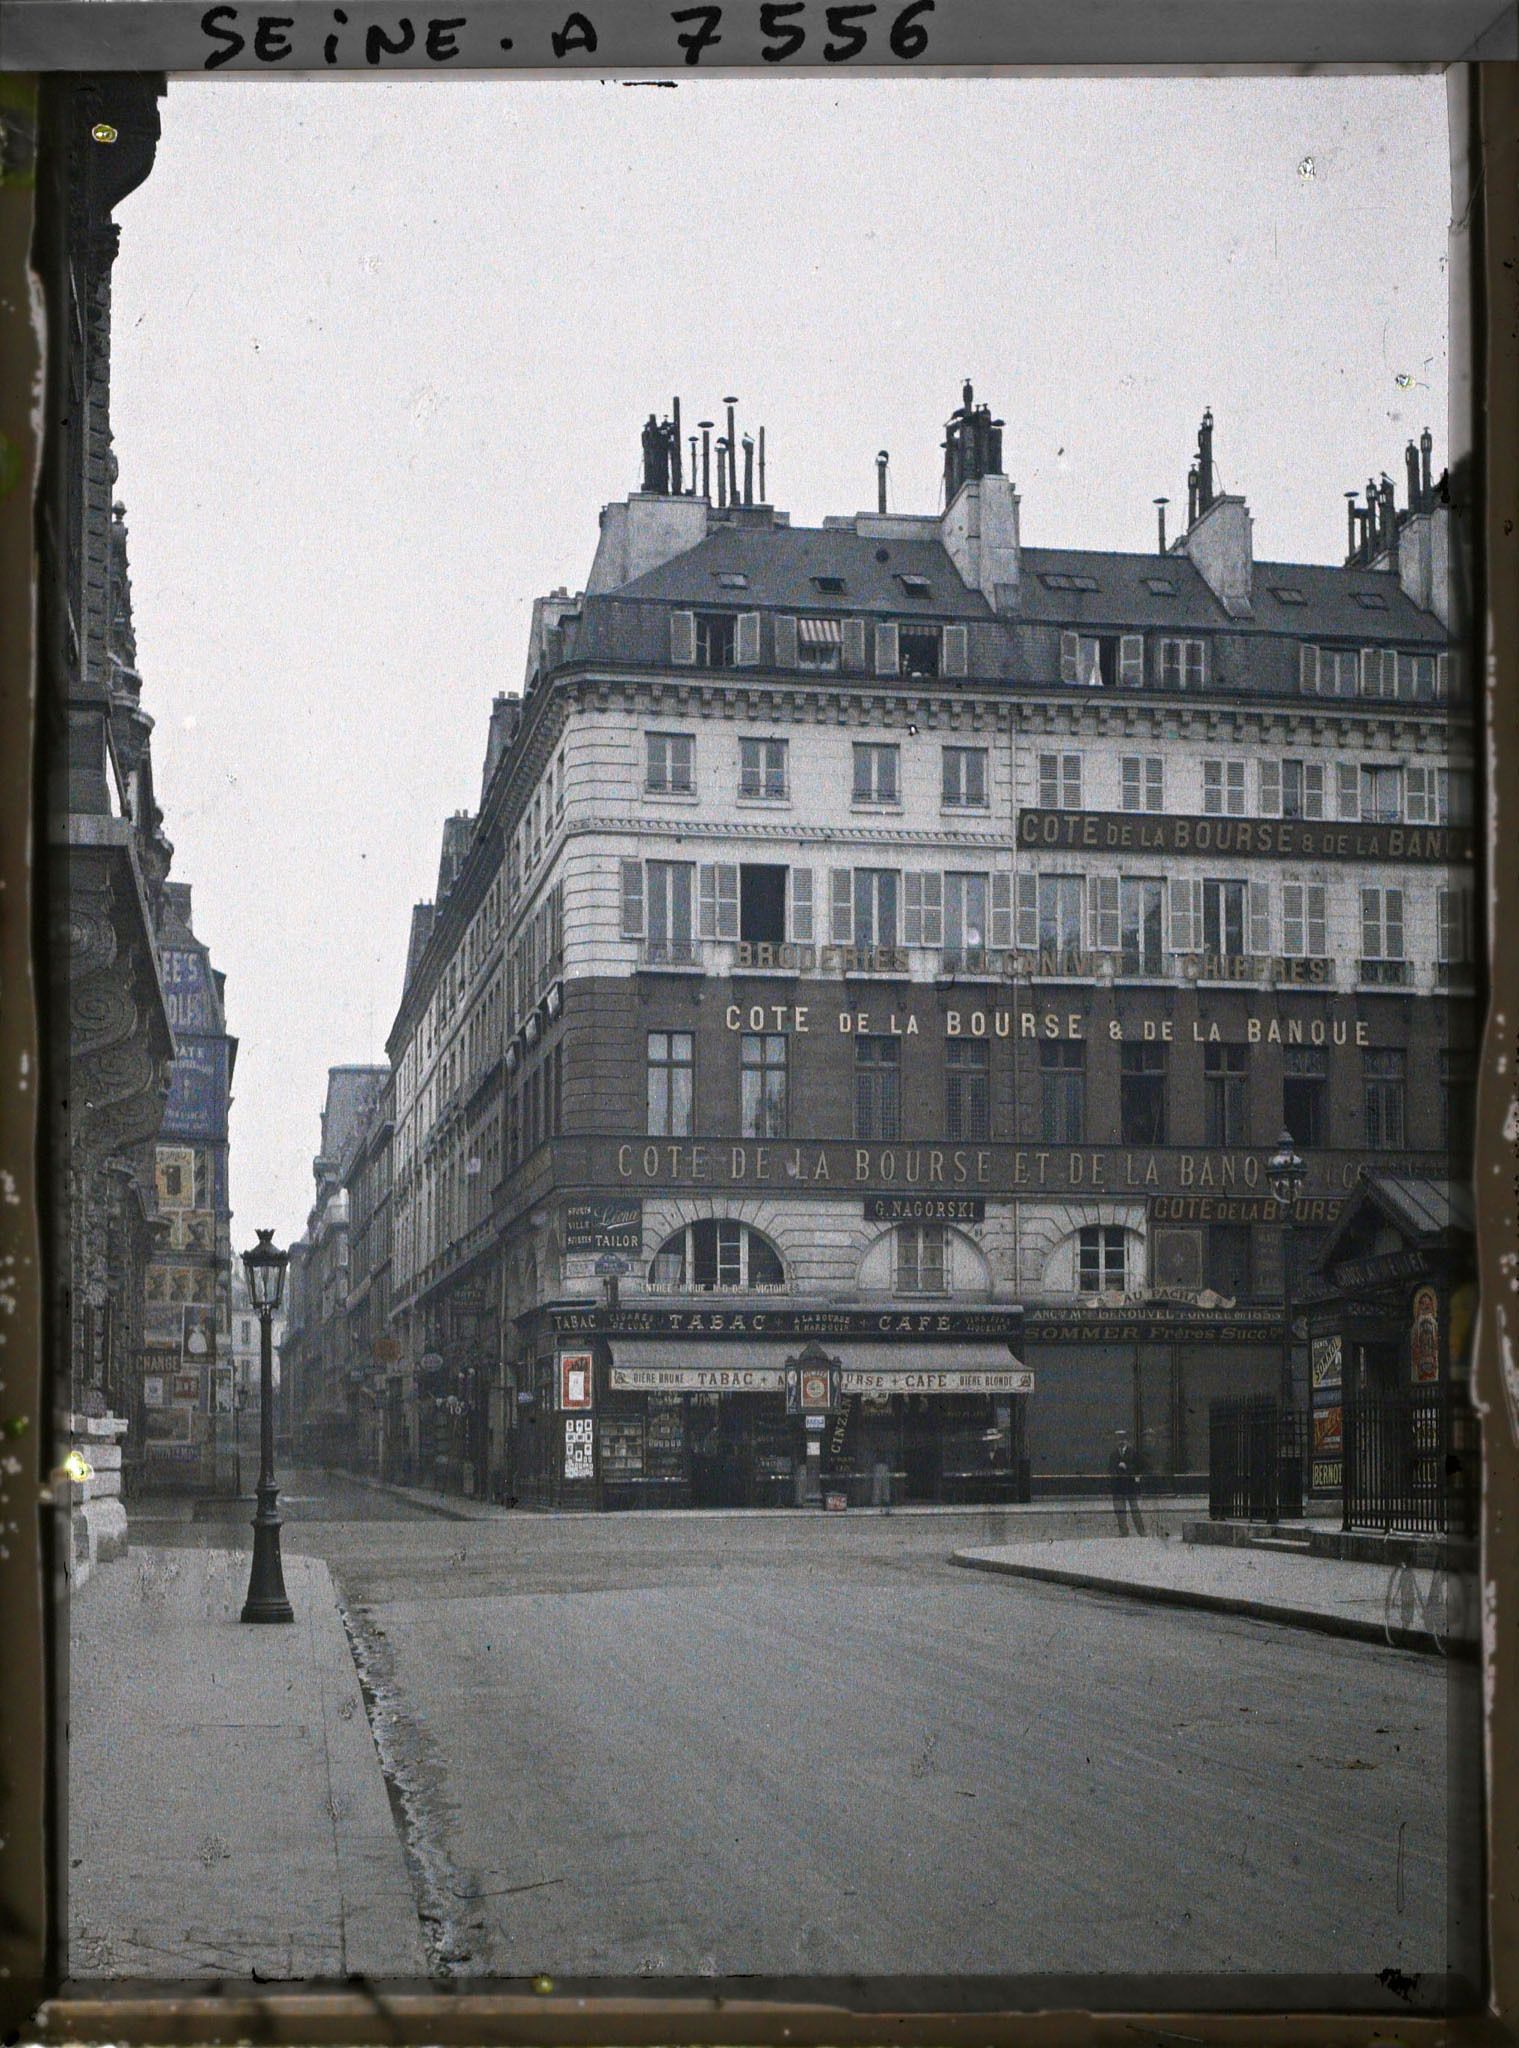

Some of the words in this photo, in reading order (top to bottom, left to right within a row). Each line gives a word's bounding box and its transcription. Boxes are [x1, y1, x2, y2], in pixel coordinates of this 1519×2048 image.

[551, 12, 599, 58] A
[670, 0, 936, 65] 7556
[1022, 814, 1100, 846] COTE
[1107, 822, 1132, 846] DE
[1141, 826, 1166, 847] LA
[1174, 820, 1294, 852] BOURSE
[1323, 834, 1348, 855] DE
[1356, 836, 1380, 856] LA
[1388, 829, 1449, 858] BAN
[735, 941, 909, 973] BRODERIES
[1182, 954, 1324, 984] CHIFFRES
[726, 1005, 809, 1033] COTE
[839, 1013, 869, 1033] DE
[890, 1014, 919, 1035] LA
[946, 1010, 1082, 1039] BOURSE
[1109, 1020, 1123, 1040] &
[1144, 1021, 1174, 1041] DE
[1193, 1021, 1221, 1042] LA
[1248, 1018, 1369, 1046] BANQUE
[618, 1144, 706, 1178] COTE
[731, 1147, 770, 1180] DE
[795, 1148, 831, 1180] LA
[855, 1149, 992, 1184] BOURSE
[1014, 1152, 1050, 1185] ET
[1069, 1152, 1106, 1185] DE
[1127, 1154, 1160, 1186] LA
[1180, 1154, 1260, 1189] BANQ
[1154, 1198, 1216, 1219] COTE
[1217, 1201, 1237, 1218] DE
[1240, 1202, 1258, 1219] LA
[1263, 1201, 1344, 1222] BURS
[595, 1234, 639, 1247] TAILOR
[1123, 1290, 1143, 1304] AU
[1151, 1288, 1199, 1304] PACHA
[555, 1315, 597, 1329] TABAC
[669, 1314, 767, 1330] TABAC
[815, 1313, 850, 1324] BOURSE
[879, 1316, 952, 1331] CAFE
[1025, 1326, 1139, 1340] SOMMER
[136, 1355, 179, 1374] CHANGE
[658, 1372, 685, 1384] BRUNE
[697, 1371, 753, 1386] TABAC
[841, 1372, 884, 1388] URSE
[905, 1374, 947, 1388] CAFE
[985, 1375, 1013, 1387] BLONDE
